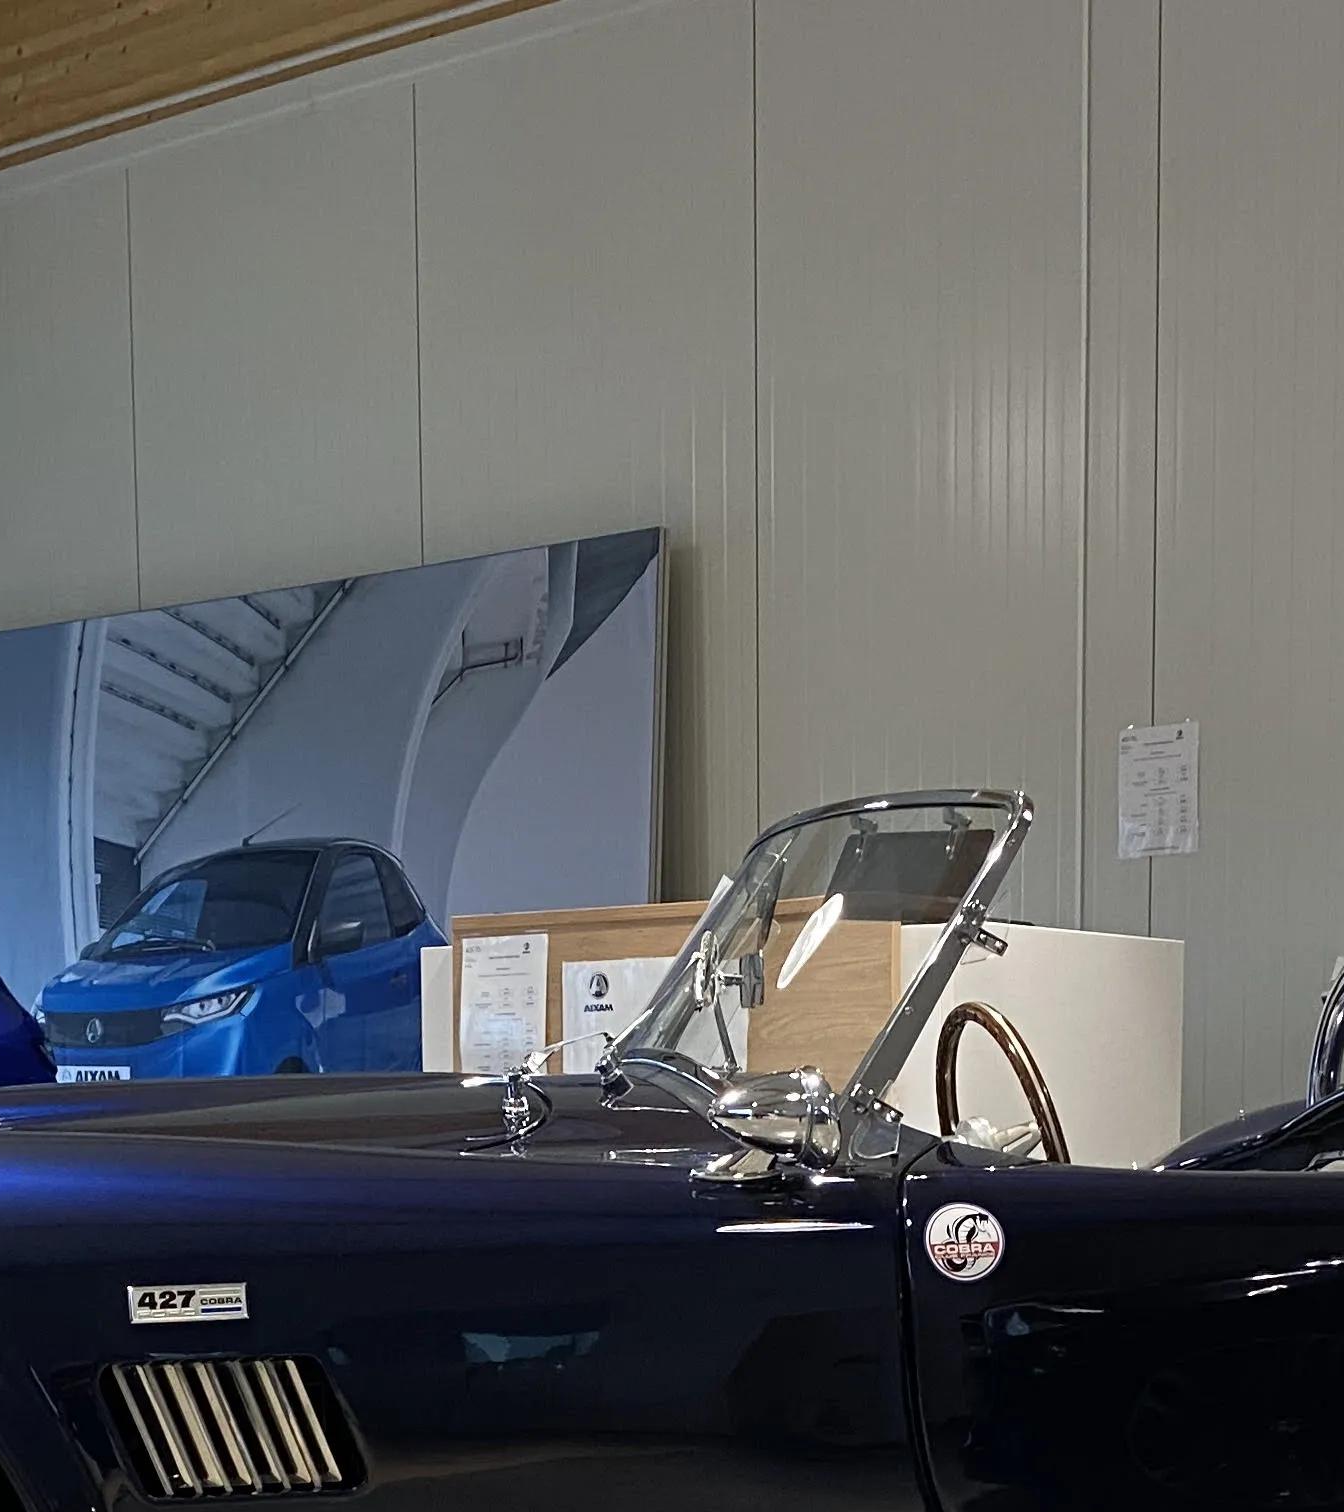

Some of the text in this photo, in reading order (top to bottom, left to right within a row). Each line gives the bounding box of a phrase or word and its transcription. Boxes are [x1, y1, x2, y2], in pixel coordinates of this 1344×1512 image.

[584, 1003, 613, 1013] AIXAM
[76, 1070, 120, 1081] AIXAM
[933, 1243, 995, 1255] COBRA
[137, 1289, 242, 1310] 427 COBRA
